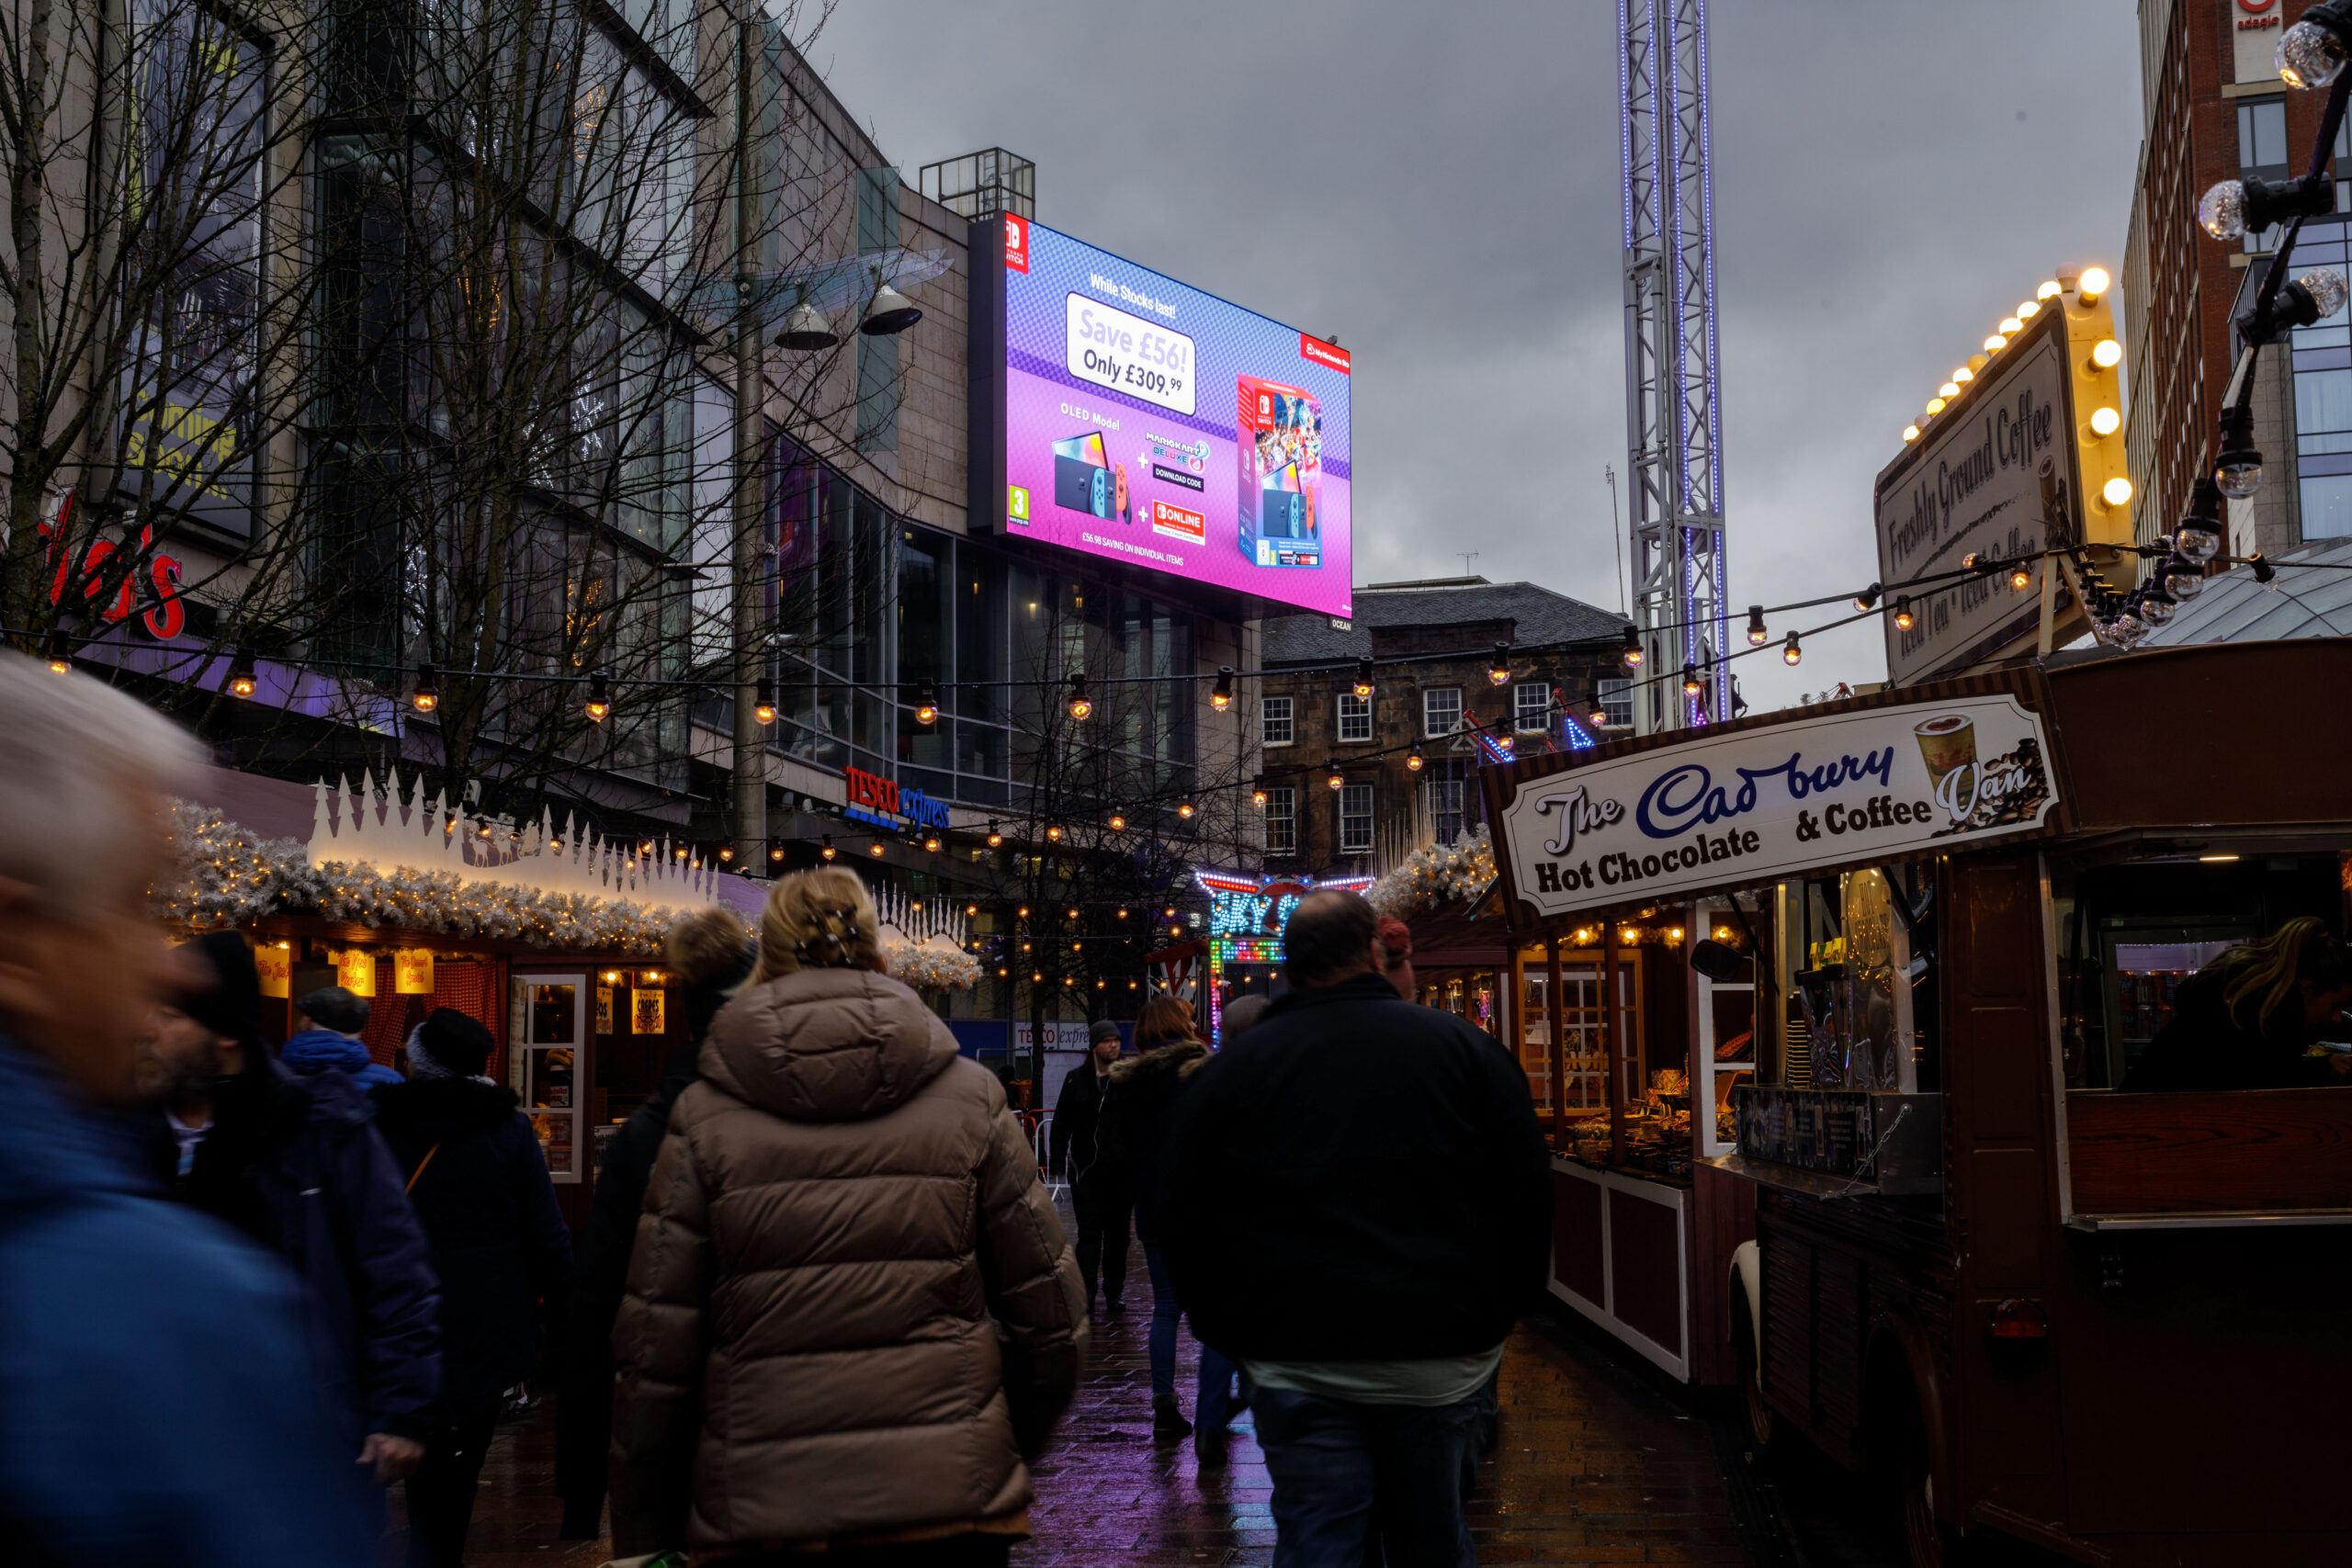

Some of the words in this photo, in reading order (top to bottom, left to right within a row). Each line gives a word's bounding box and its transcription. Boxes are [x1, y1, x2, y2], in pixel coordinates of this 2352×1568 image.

[2237, 14, 2279, 30] adagio
[1090, 272, 1118, 297] While
[1121, 285, 1153, 310] Stocks
[1155, 297, 1176, 319] last!
[1079, 309, 1133, 353] Save
[1139, 332, 1187, 373] £56!
[1084, 349, 1122, 383] Only
[1125, 364, 1182, 396] £309.99
[1060, 402, 1090, 422] OLED
[1092, 412, 1120, 431] Model
[1153, 446, 1188, 464] DELUXE
[1155, 468, 1186, 483] DOWNLOAD
[1187, 478, 1202, 489] CODE
[1888, 479, 1938, 575] Freshly
[1939, 414, 1996, 531] Ground
[1997, 389, 2052, 469] Coffee
[1013, 490, 1023, 514] 3
[1167, 509, 1201, 527] ONLINE
[1082, 532, 1102, 545] £56.98
[1102, 537, 1125, 551] SAVING
[1125, 543, 1134, 553] ON
[1135, 546, 1165, 562] INDIVIDUAL
[1166, 554, 1183, 566] ITEMS
[1332, 618, 1351, 631] OCEAN
[842, 765, 899, 814] TESCO
[899, 787, 951, 830] express
[1535, 785, 1623, 855] The
[1635, 746, 1894, 839] Cadbury
[1935, 761, 2031, 822] Van
[1535, 860, 1595, 893] Hot
[1599, 828, 1760, 886] Chocolate
[1795, 809, 1821, 842] &
[1825, 795, 1932, 835] Coffee
[1018, 1029, 1056, 1044] TECO
